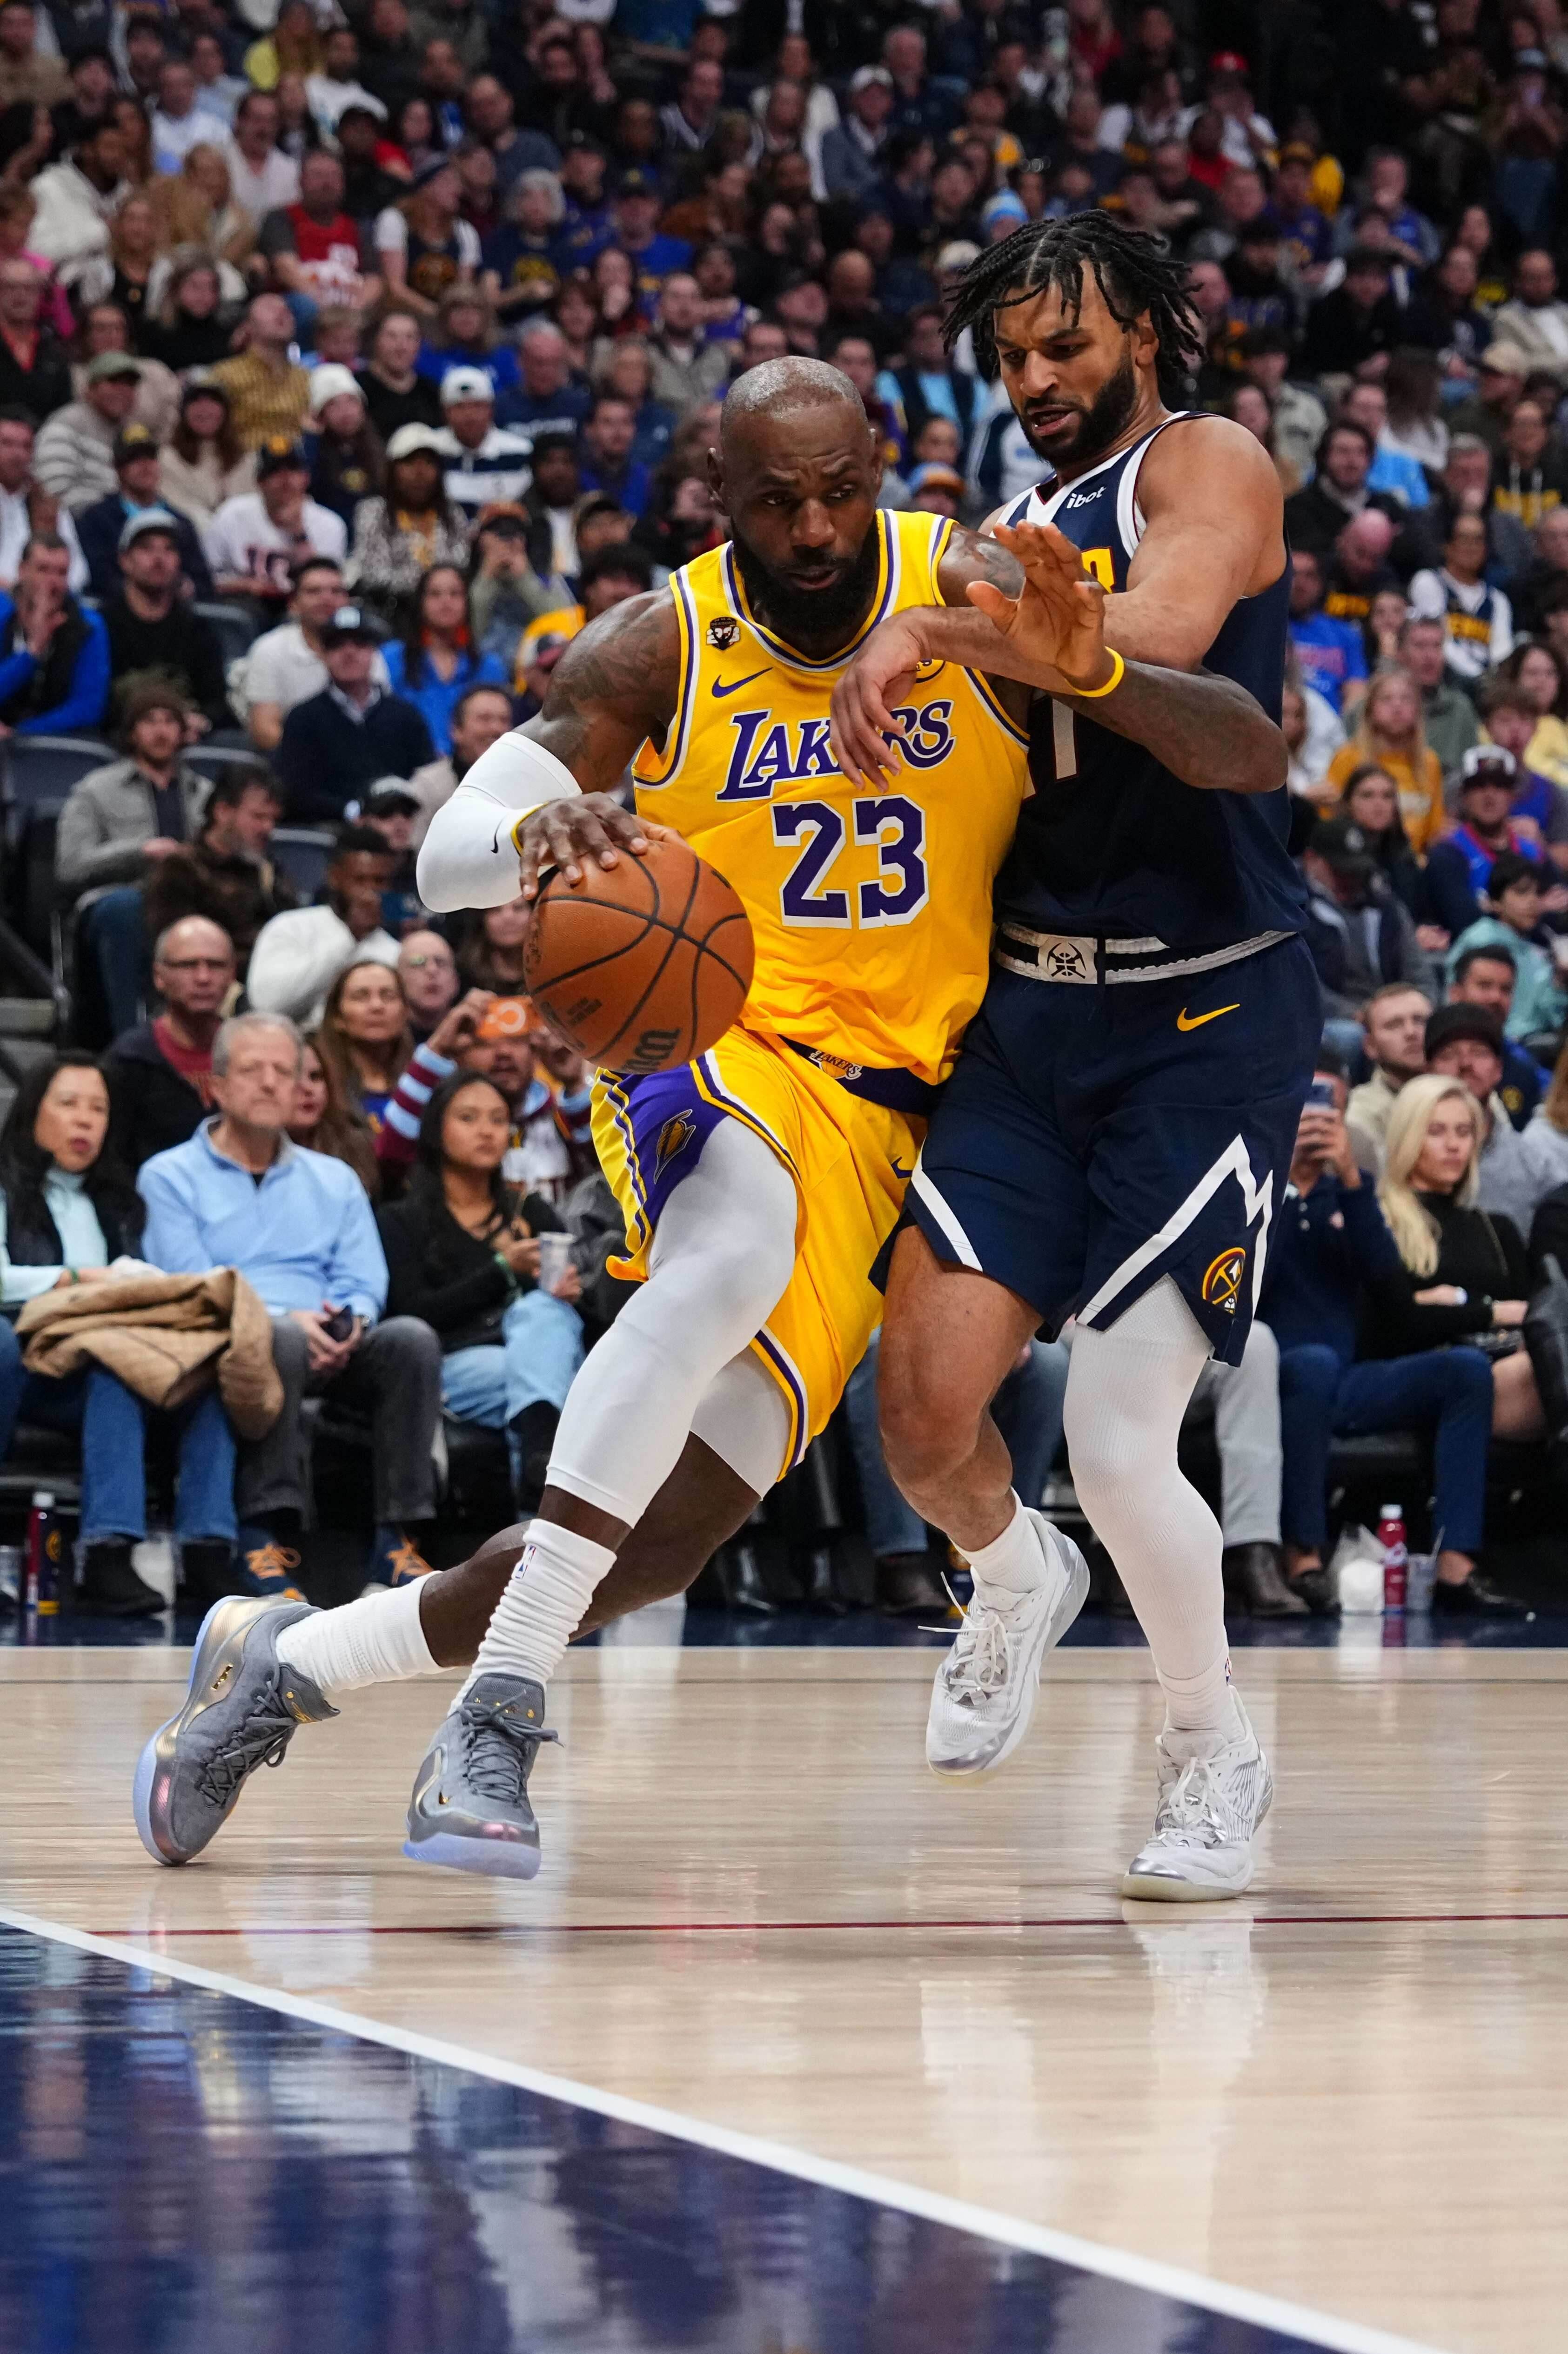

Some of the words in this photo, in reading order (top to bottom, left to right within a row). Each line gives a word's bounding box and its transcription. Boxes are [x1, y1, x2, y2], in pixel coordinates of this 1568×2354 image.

[715, 699, 957, 802] LAKRS
[771, 794, 929, 929] 23
[813, 1051, 861, 1079] LAKERS
